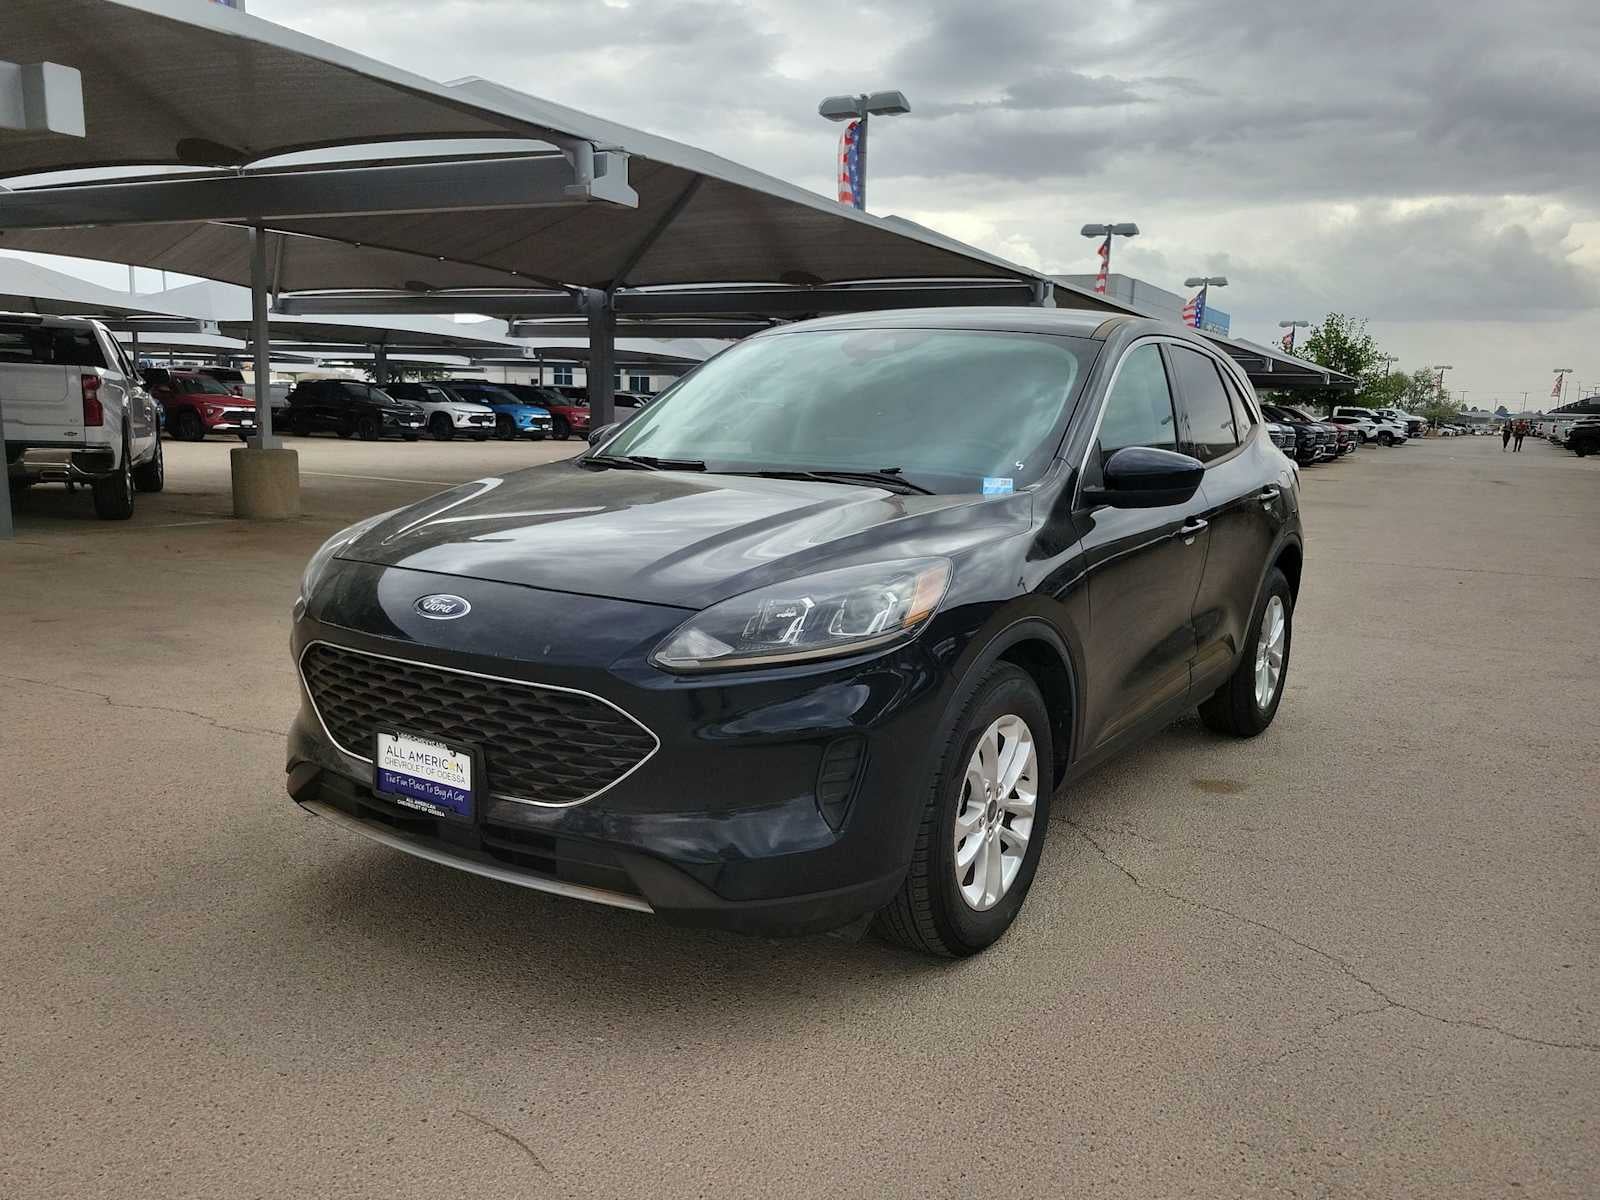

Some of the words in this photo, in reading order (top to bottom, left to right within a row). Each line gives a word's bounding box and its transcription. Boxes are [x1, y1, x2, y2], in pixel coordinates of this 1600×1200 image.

[423, 598, 457, 613] Ford
[386, 745, 405, 760] ALL
[384, 756, 424, 773] CHEVROLET
[425, 766, 436, 776] OF
[437, 770, 465, 784] ODESSA
[384, 773, 396, 783] The
[408, 778, 425, 791] Place
[425, 783, 433, 793] To
[434, 786, 446, 800] Buy
[446, 789, 453, 800] A
